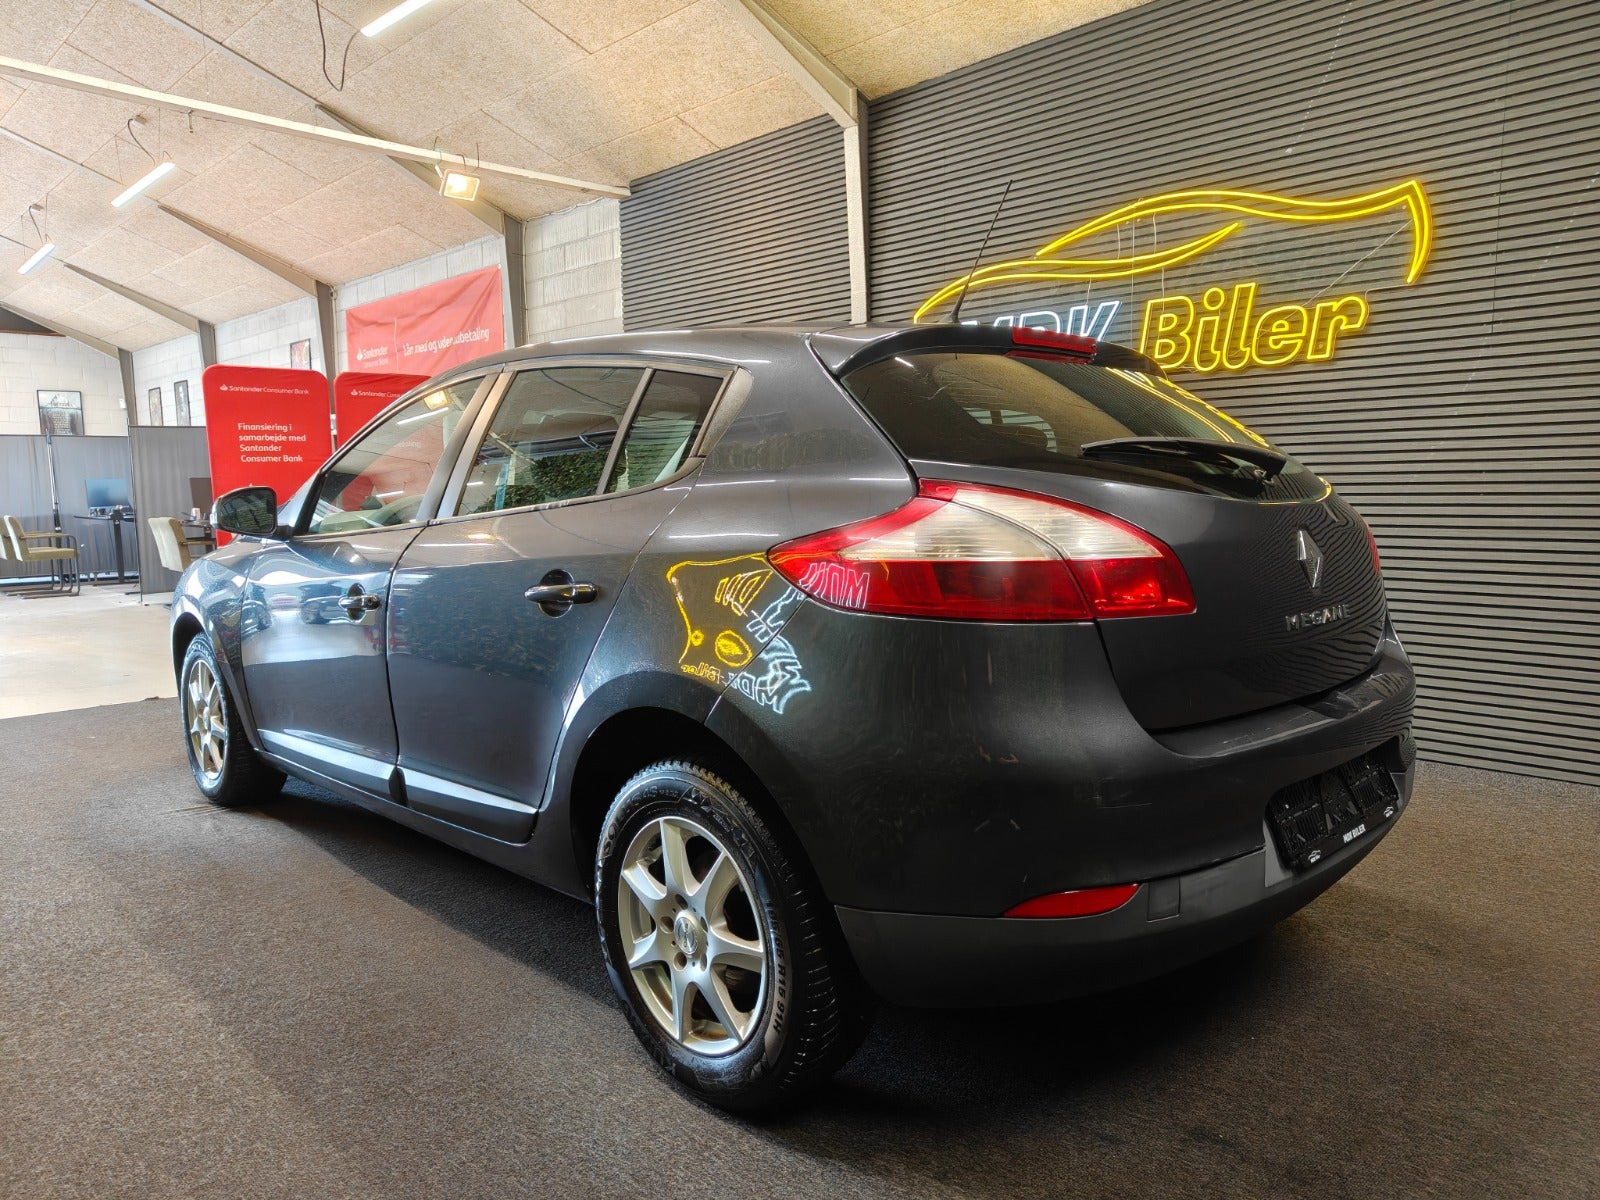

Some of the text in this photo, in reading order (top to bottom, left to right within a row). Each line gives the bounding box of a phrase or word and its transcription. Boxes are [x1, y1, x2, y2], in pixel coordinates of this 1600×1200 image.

[1139, 283, 1368, 372] Biler
[229, 385, 263, 393] Santander
[237, 422, 288, 432] Finansiering
[239, 434, 307, 442] samarbejde med
[240, 444, 282, 452] Santander
[240, 454, 303, 463] Consumer Bank
[1285, 604, 1351, 632] MEGANE
[773, 1000, 786, 1035] 91H
